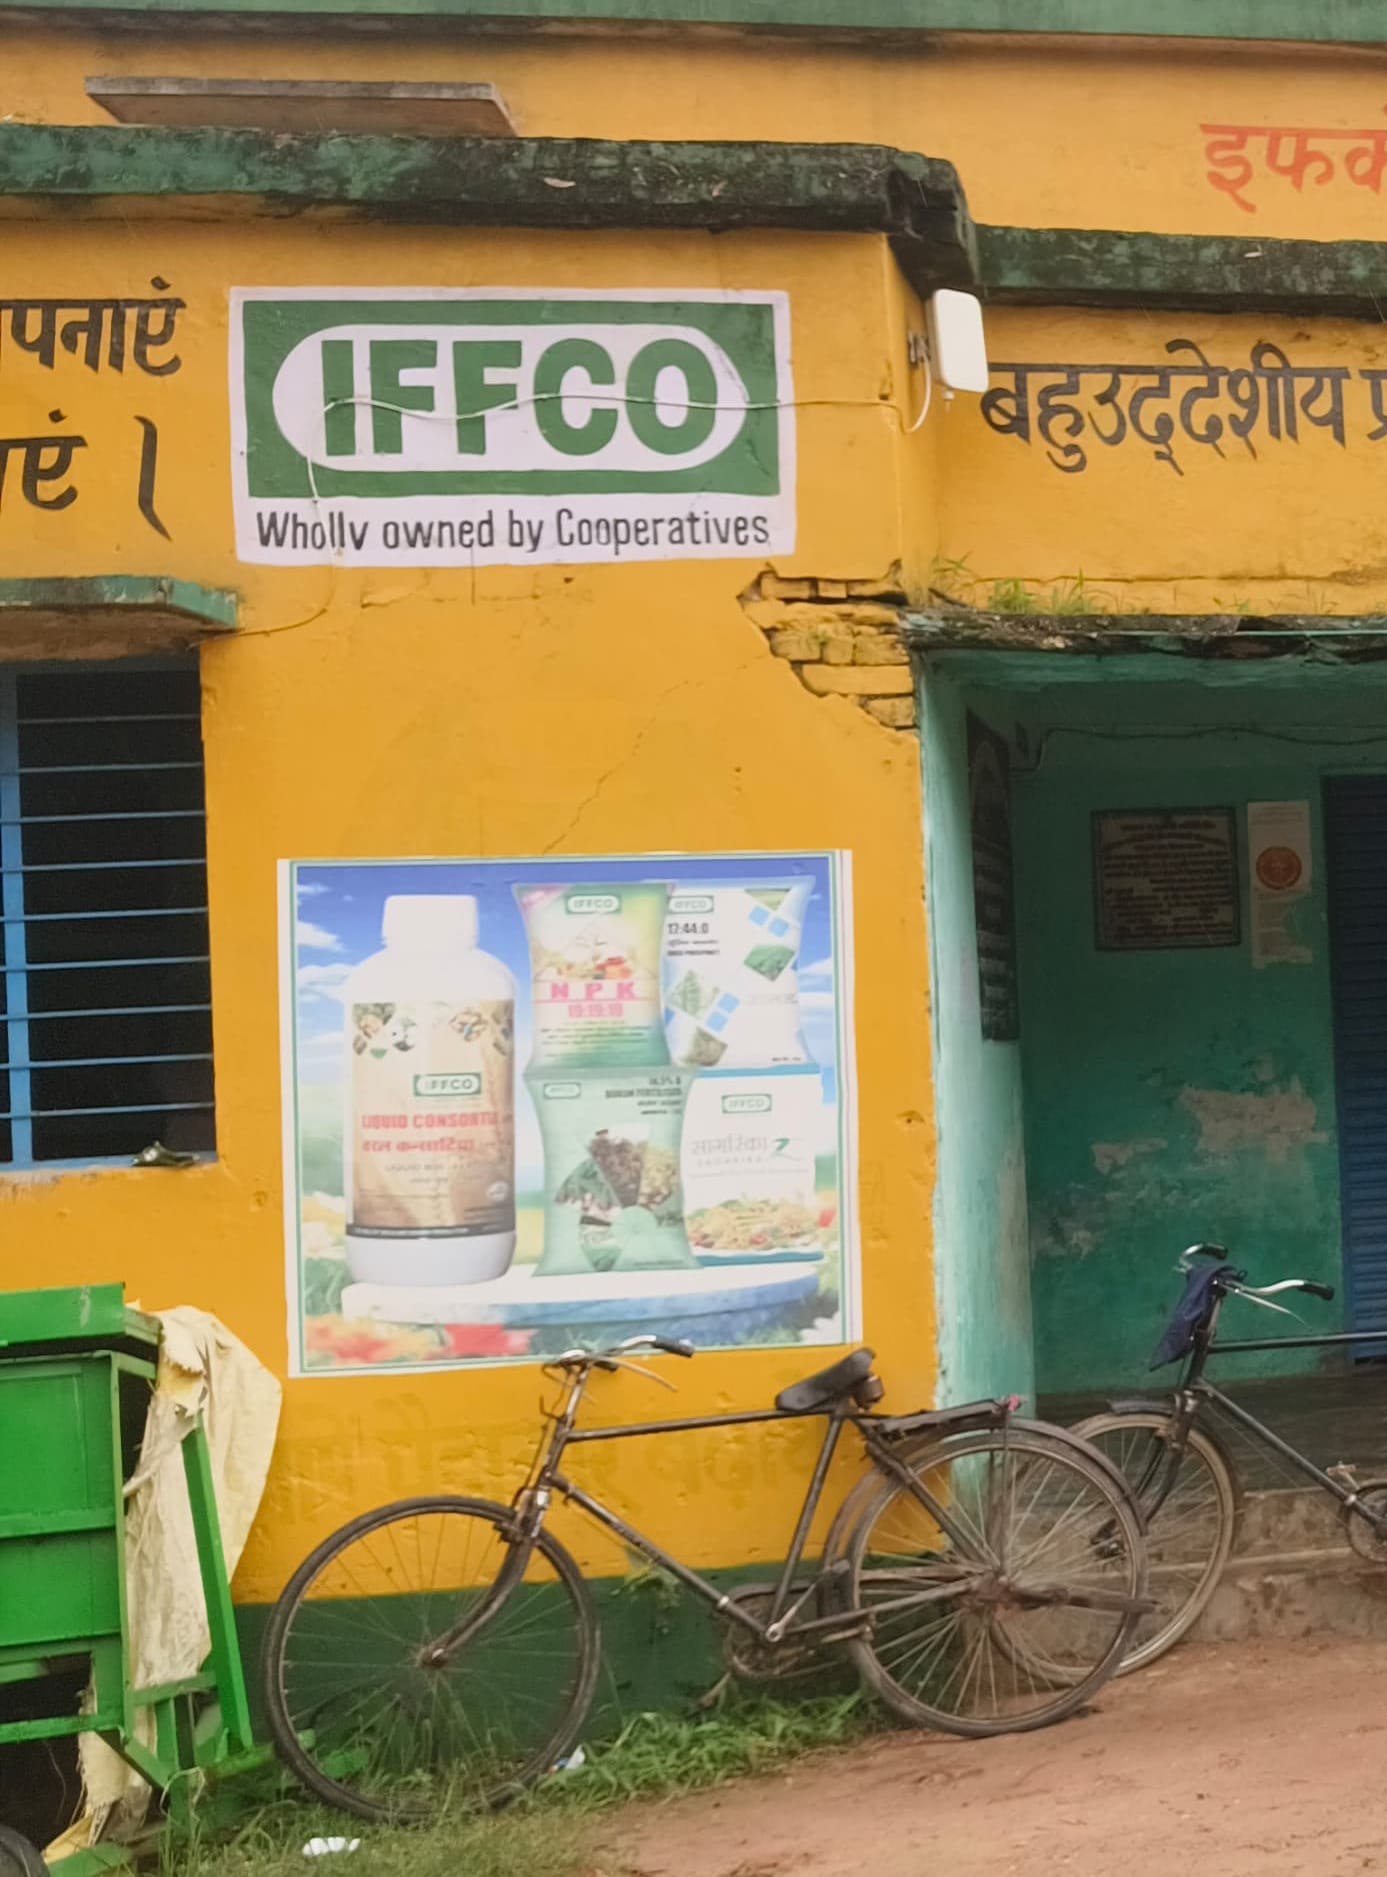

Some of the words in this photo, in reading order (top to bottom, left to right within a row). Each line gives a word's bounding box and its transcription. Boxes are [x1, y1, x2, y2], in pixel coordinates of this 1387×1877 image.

[0, 276, 187, 376] पनाएं
[320, 337, 720, 458] IFFCO
[383, 509, 494, 549] owned
[508, 509, 544, 553] by
[556, 508, 770, 556] Cooperatives
